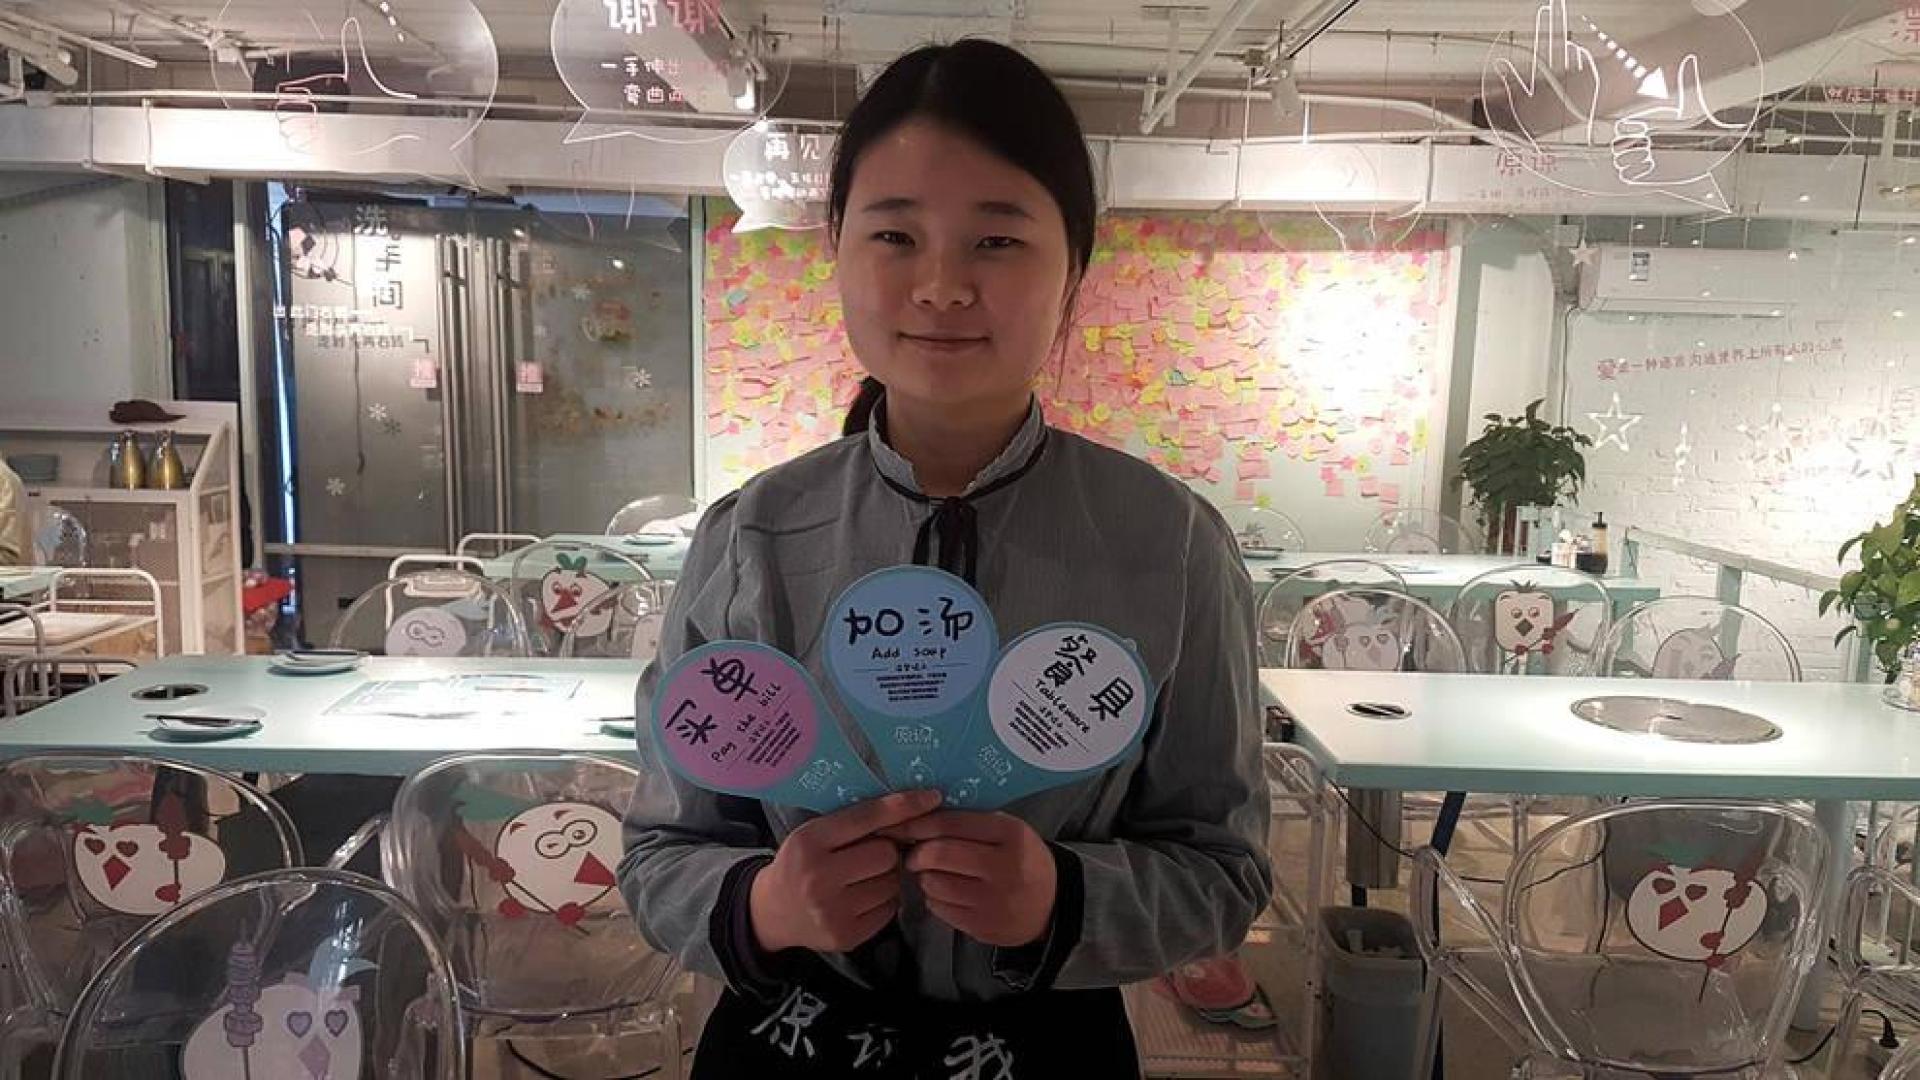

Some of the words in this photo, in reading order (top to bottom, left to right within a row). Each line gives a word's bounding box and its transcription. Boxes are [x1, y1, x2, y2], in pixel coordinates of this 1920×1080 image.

[764, 133, 821, 160] 再见
[843, 597, 973, 645] 加汤
[871, 647, 900, 660] Add
